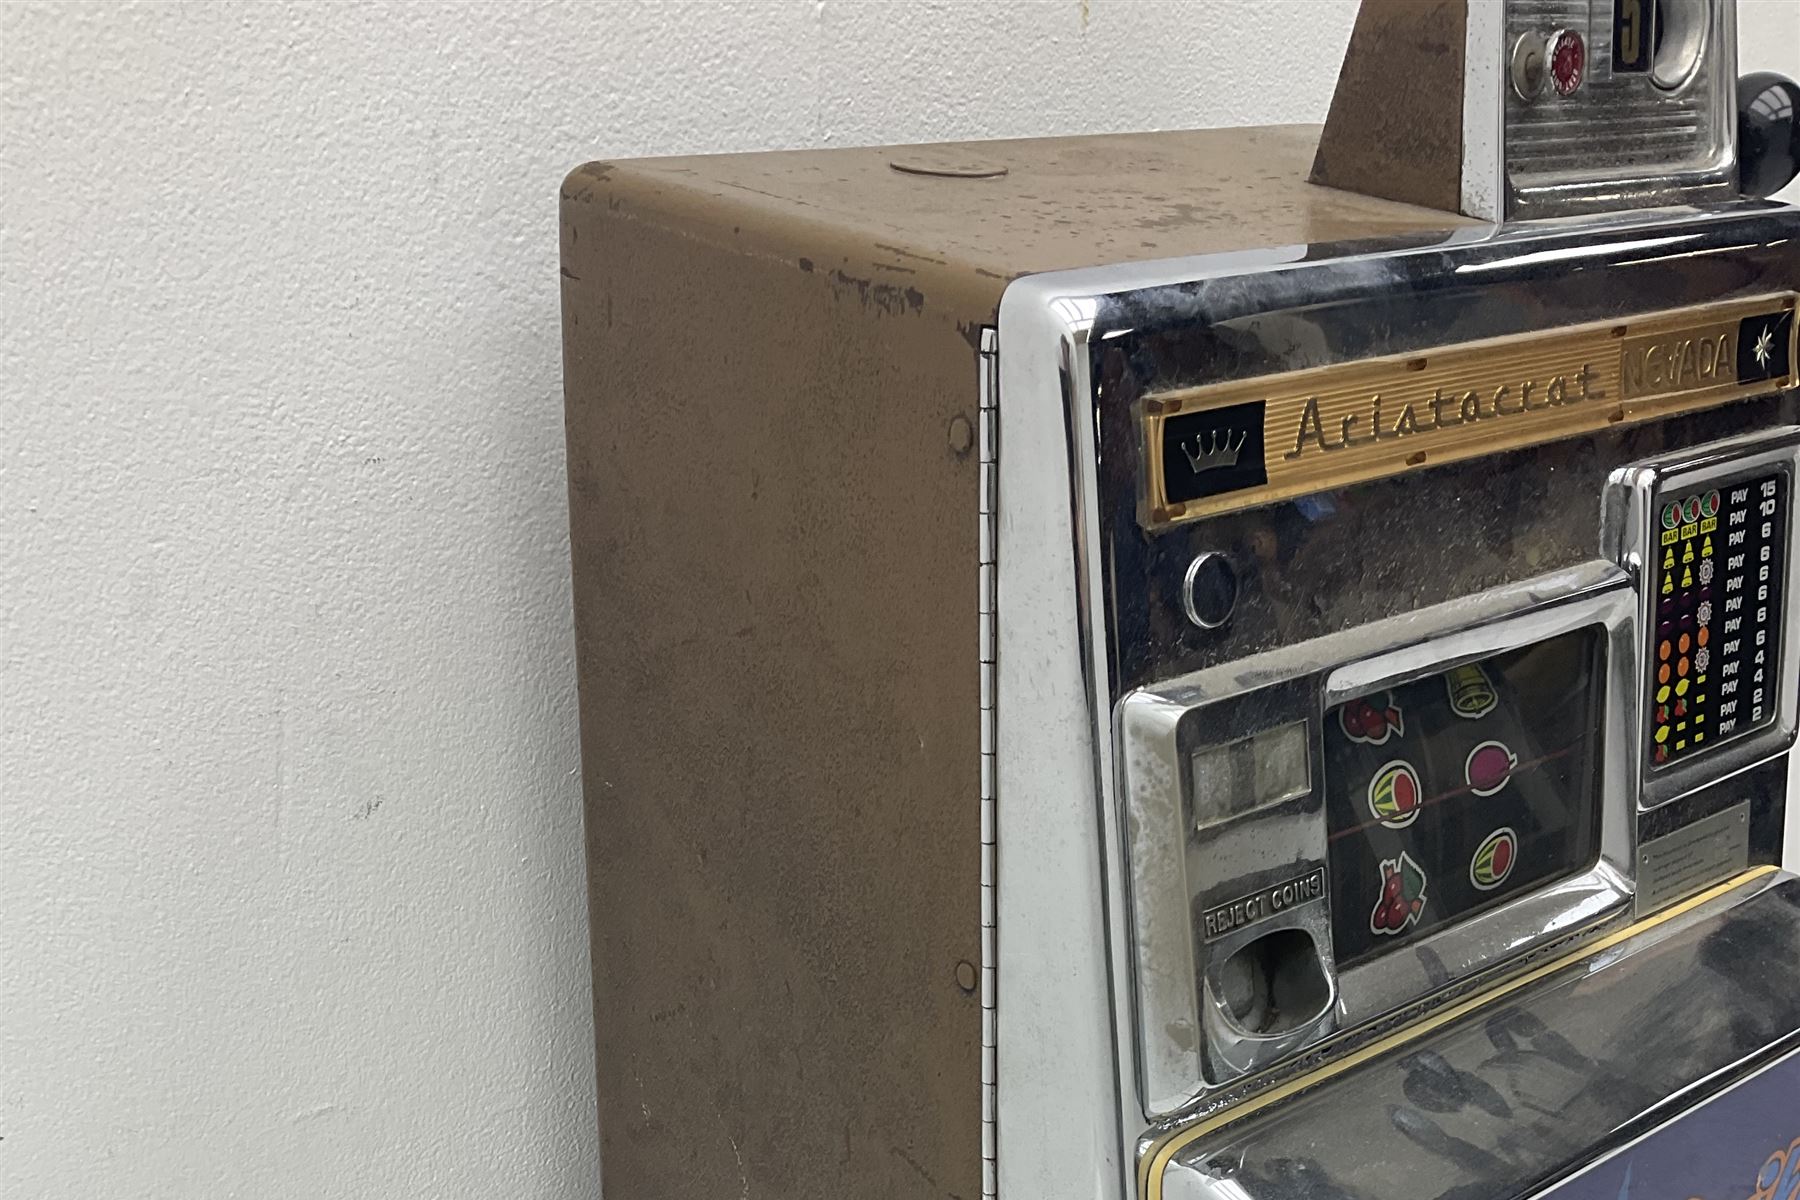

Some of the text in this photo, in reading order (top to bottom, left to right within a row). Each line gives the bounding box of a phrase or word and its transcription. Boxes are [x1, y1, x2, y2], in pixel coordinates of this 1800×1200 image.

[1284, 334, 1732, 460] Aristocrat NEVADA
[1731, 480, 1776, 504] PAY 15
[1663, 499, 1776, 544] BAR BAR BAR PAY 10
[1729, 522, 1771, 546] PAY 6
[1728, 545, 1770, 570] PAY 6
[1727, 565, 1769, 592] PAY 6
[1726, 585, 1767, 612] PAY 6
[1724, 606, 1767, 634] PAY 6
[1723, 629, 1766, 656] PAY 6
[1722, 650, 1765, 677] PAY 4
[1721, 668, 1764, 696] PAY 4
[1720, 688, 1763, 717] PAY 2
[1719, 706, 1762, 735] PAY 2
[1205, 874, 1321, 938] REJECT COINS
